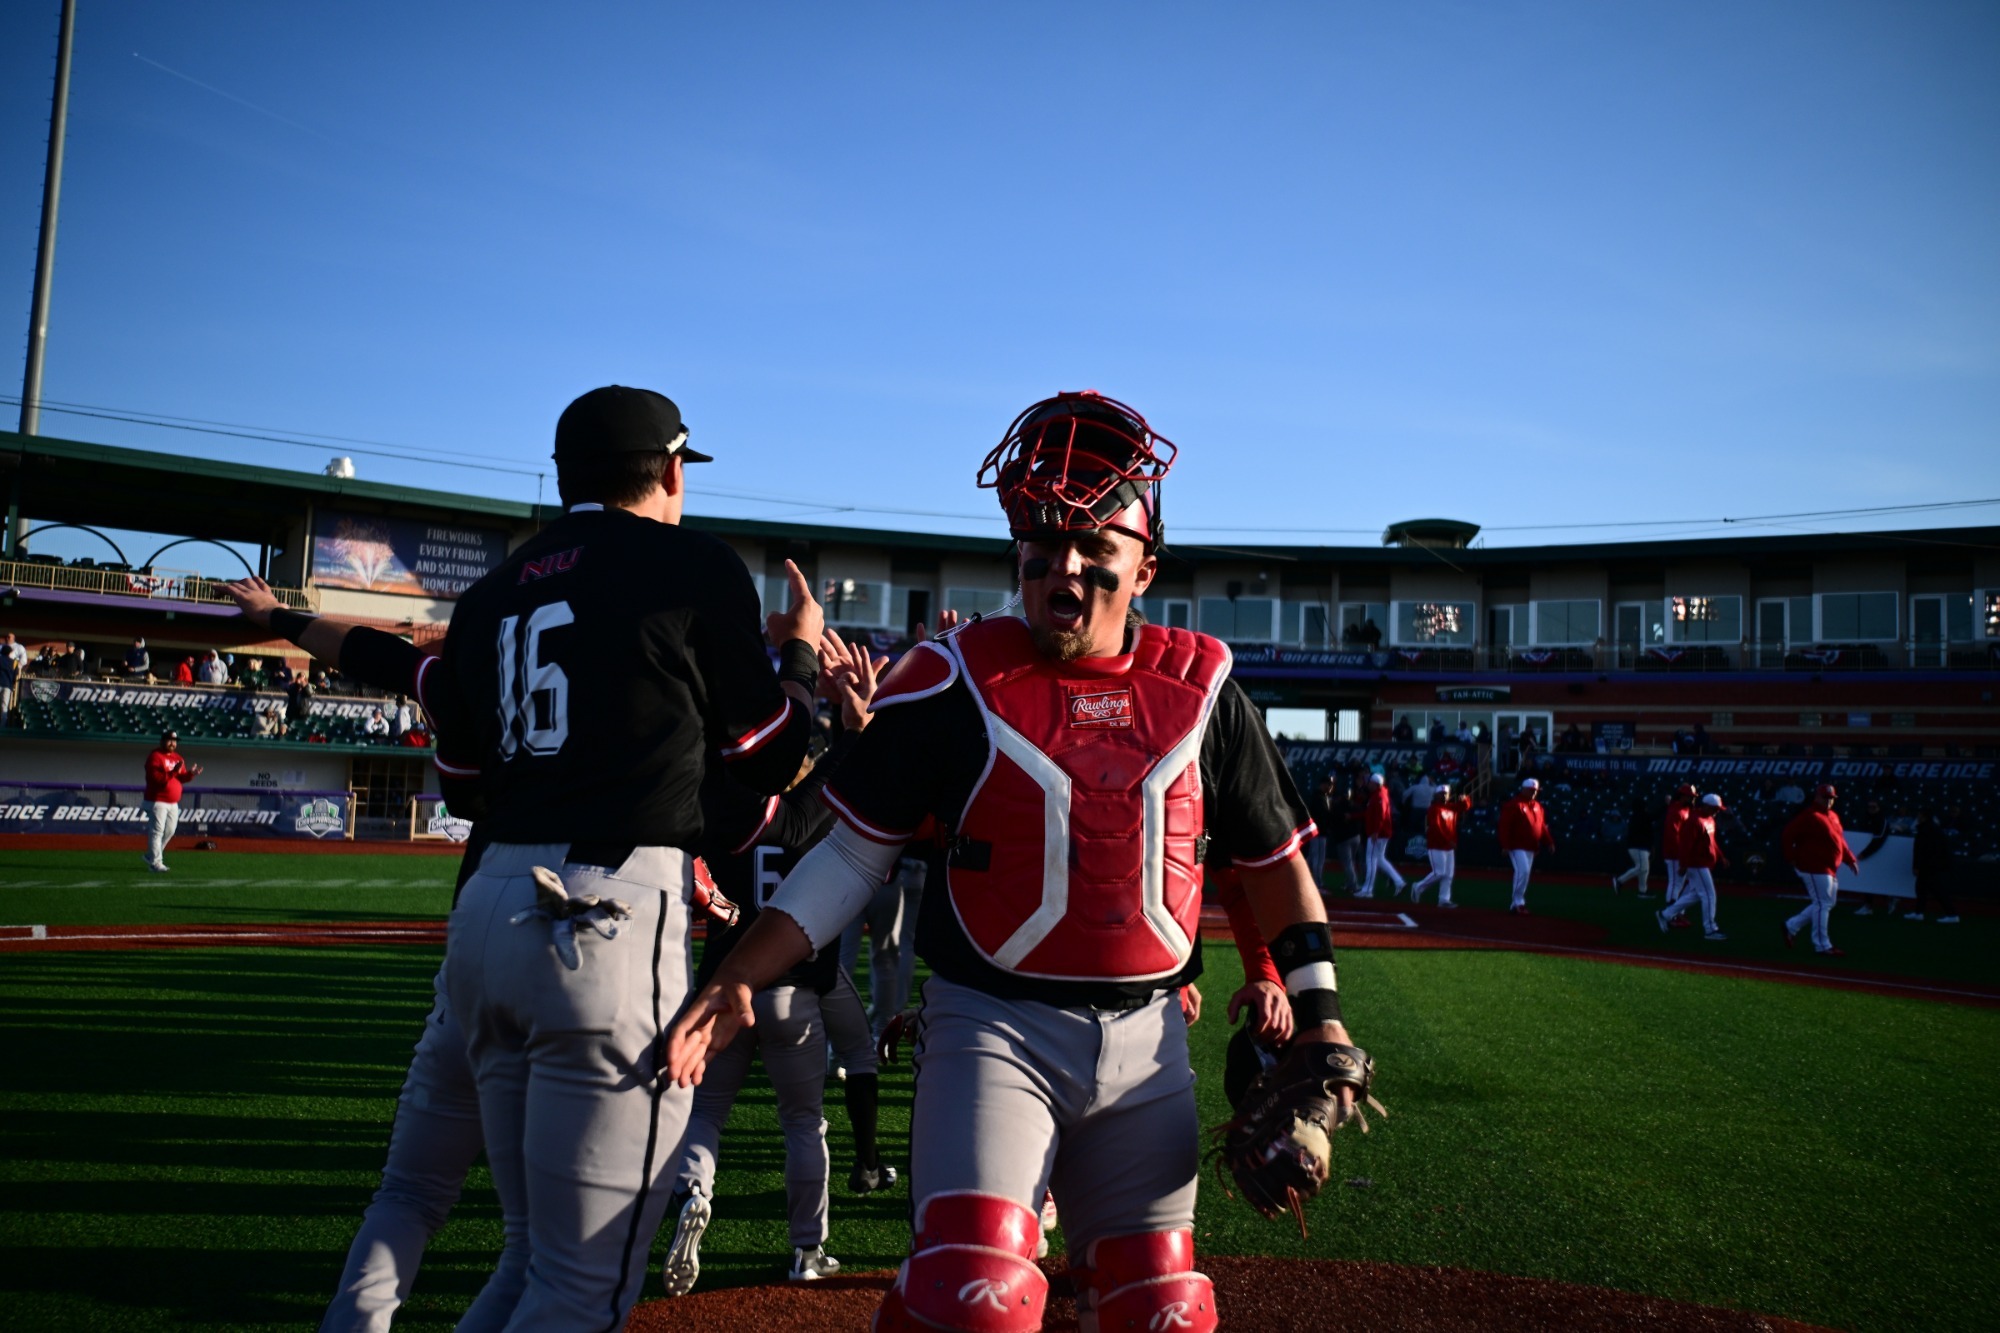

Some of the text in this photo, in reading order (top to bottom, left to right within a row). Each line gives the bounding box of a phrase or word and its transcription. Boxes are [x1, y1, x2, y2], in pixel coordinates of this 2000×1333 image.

[427, 528, 483, 546] FIREWORKS
[419, 544, 488, 562] EVERY FRIDAY
[415, 559, 489, 579] AND SATURDAY
[516, 545, 585, 586] NIU
[422, 577, 451, 593] HOME
[1280, 653, 1366, 664] ONFERENCE
[497, 600, 575, 763] 16
[68, 686, 377, 720] MID-AMERICAN CONRENCE
[1072, 696, 1130, 717] Rawlings
[1284, 746, 1428, 763] ONFERENCE
[1565, 758, 1607, 770] WELCOME
[1609, 758, 1620, 770] TO
[1622, 759, 1638, 771] THE
[1646, 758, 1825, 777] MID-AMERICAN
[52, 805, 149, 822] BASEBALL
[178, 809, 281, 825] URNAMENT
[753, 845, 785, 912] 6
